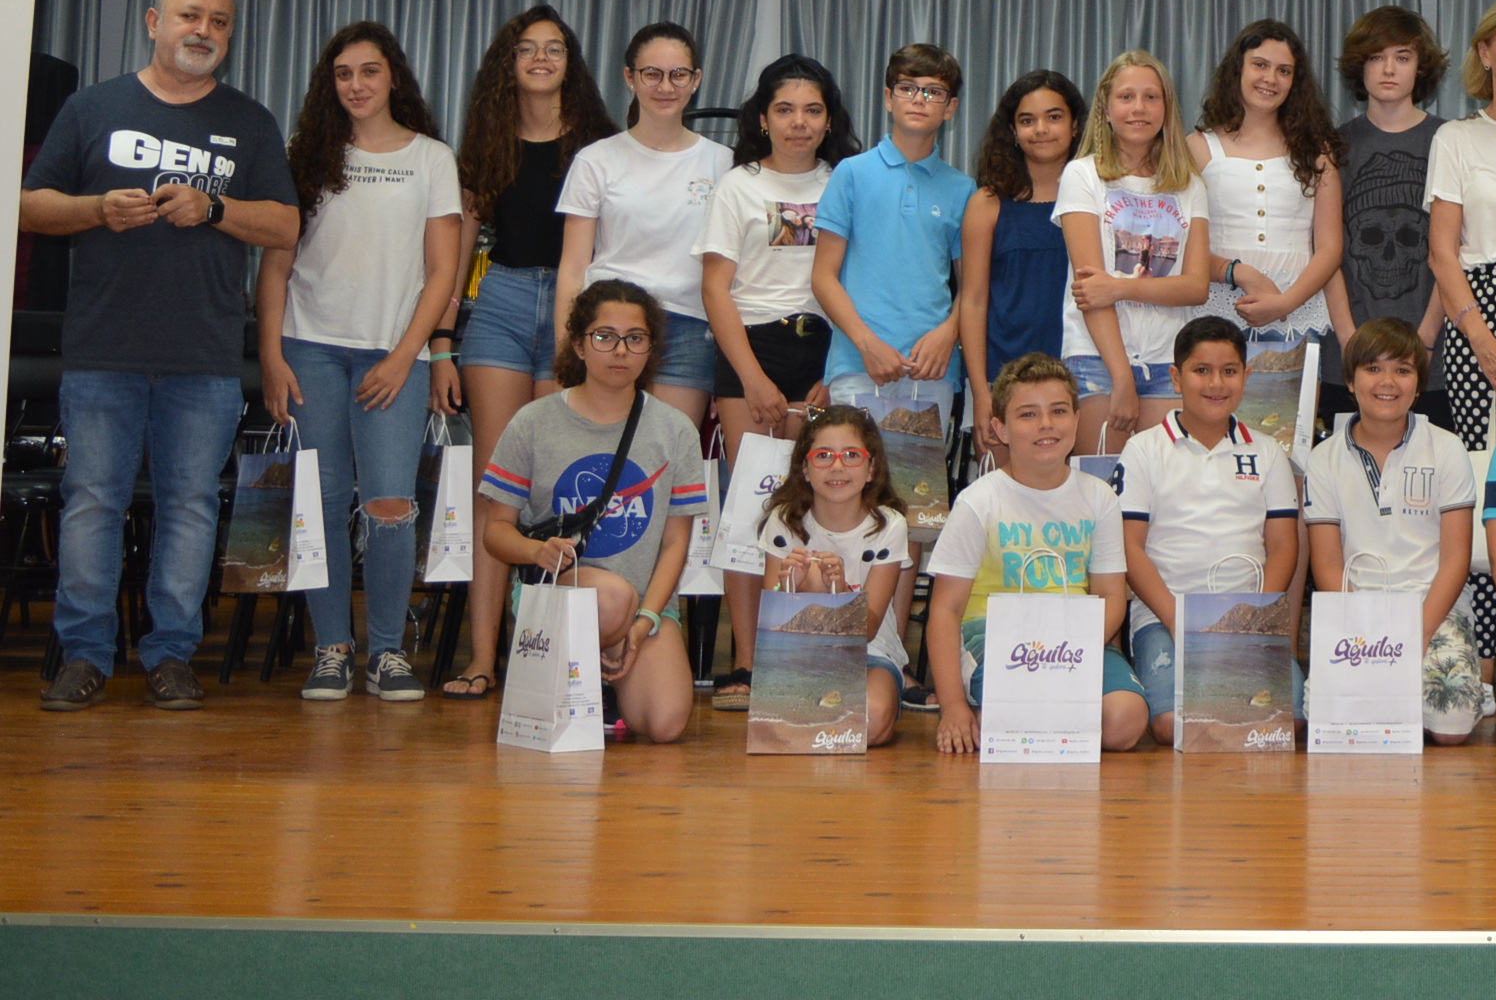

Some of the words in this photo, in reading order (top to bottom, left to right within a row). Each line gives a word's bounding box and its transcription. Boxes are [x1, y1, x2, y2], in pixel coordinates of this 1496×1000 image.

[108, 130, 211, 173] GEN
[214, 156, 236, 178] 90
[345, 165, 362, 173] THIS
[364, 166, 386, 174] THING
[1104, 197, 1133, 225] TRAVEL
[1134, 198, 1153, 208] THE
[1158, 200, 1189, 229] WORLD
[1233, 454, 1260, 476] H
[1404, 466, 1434, 508] U
[998, 521, 1032, 548] MY
